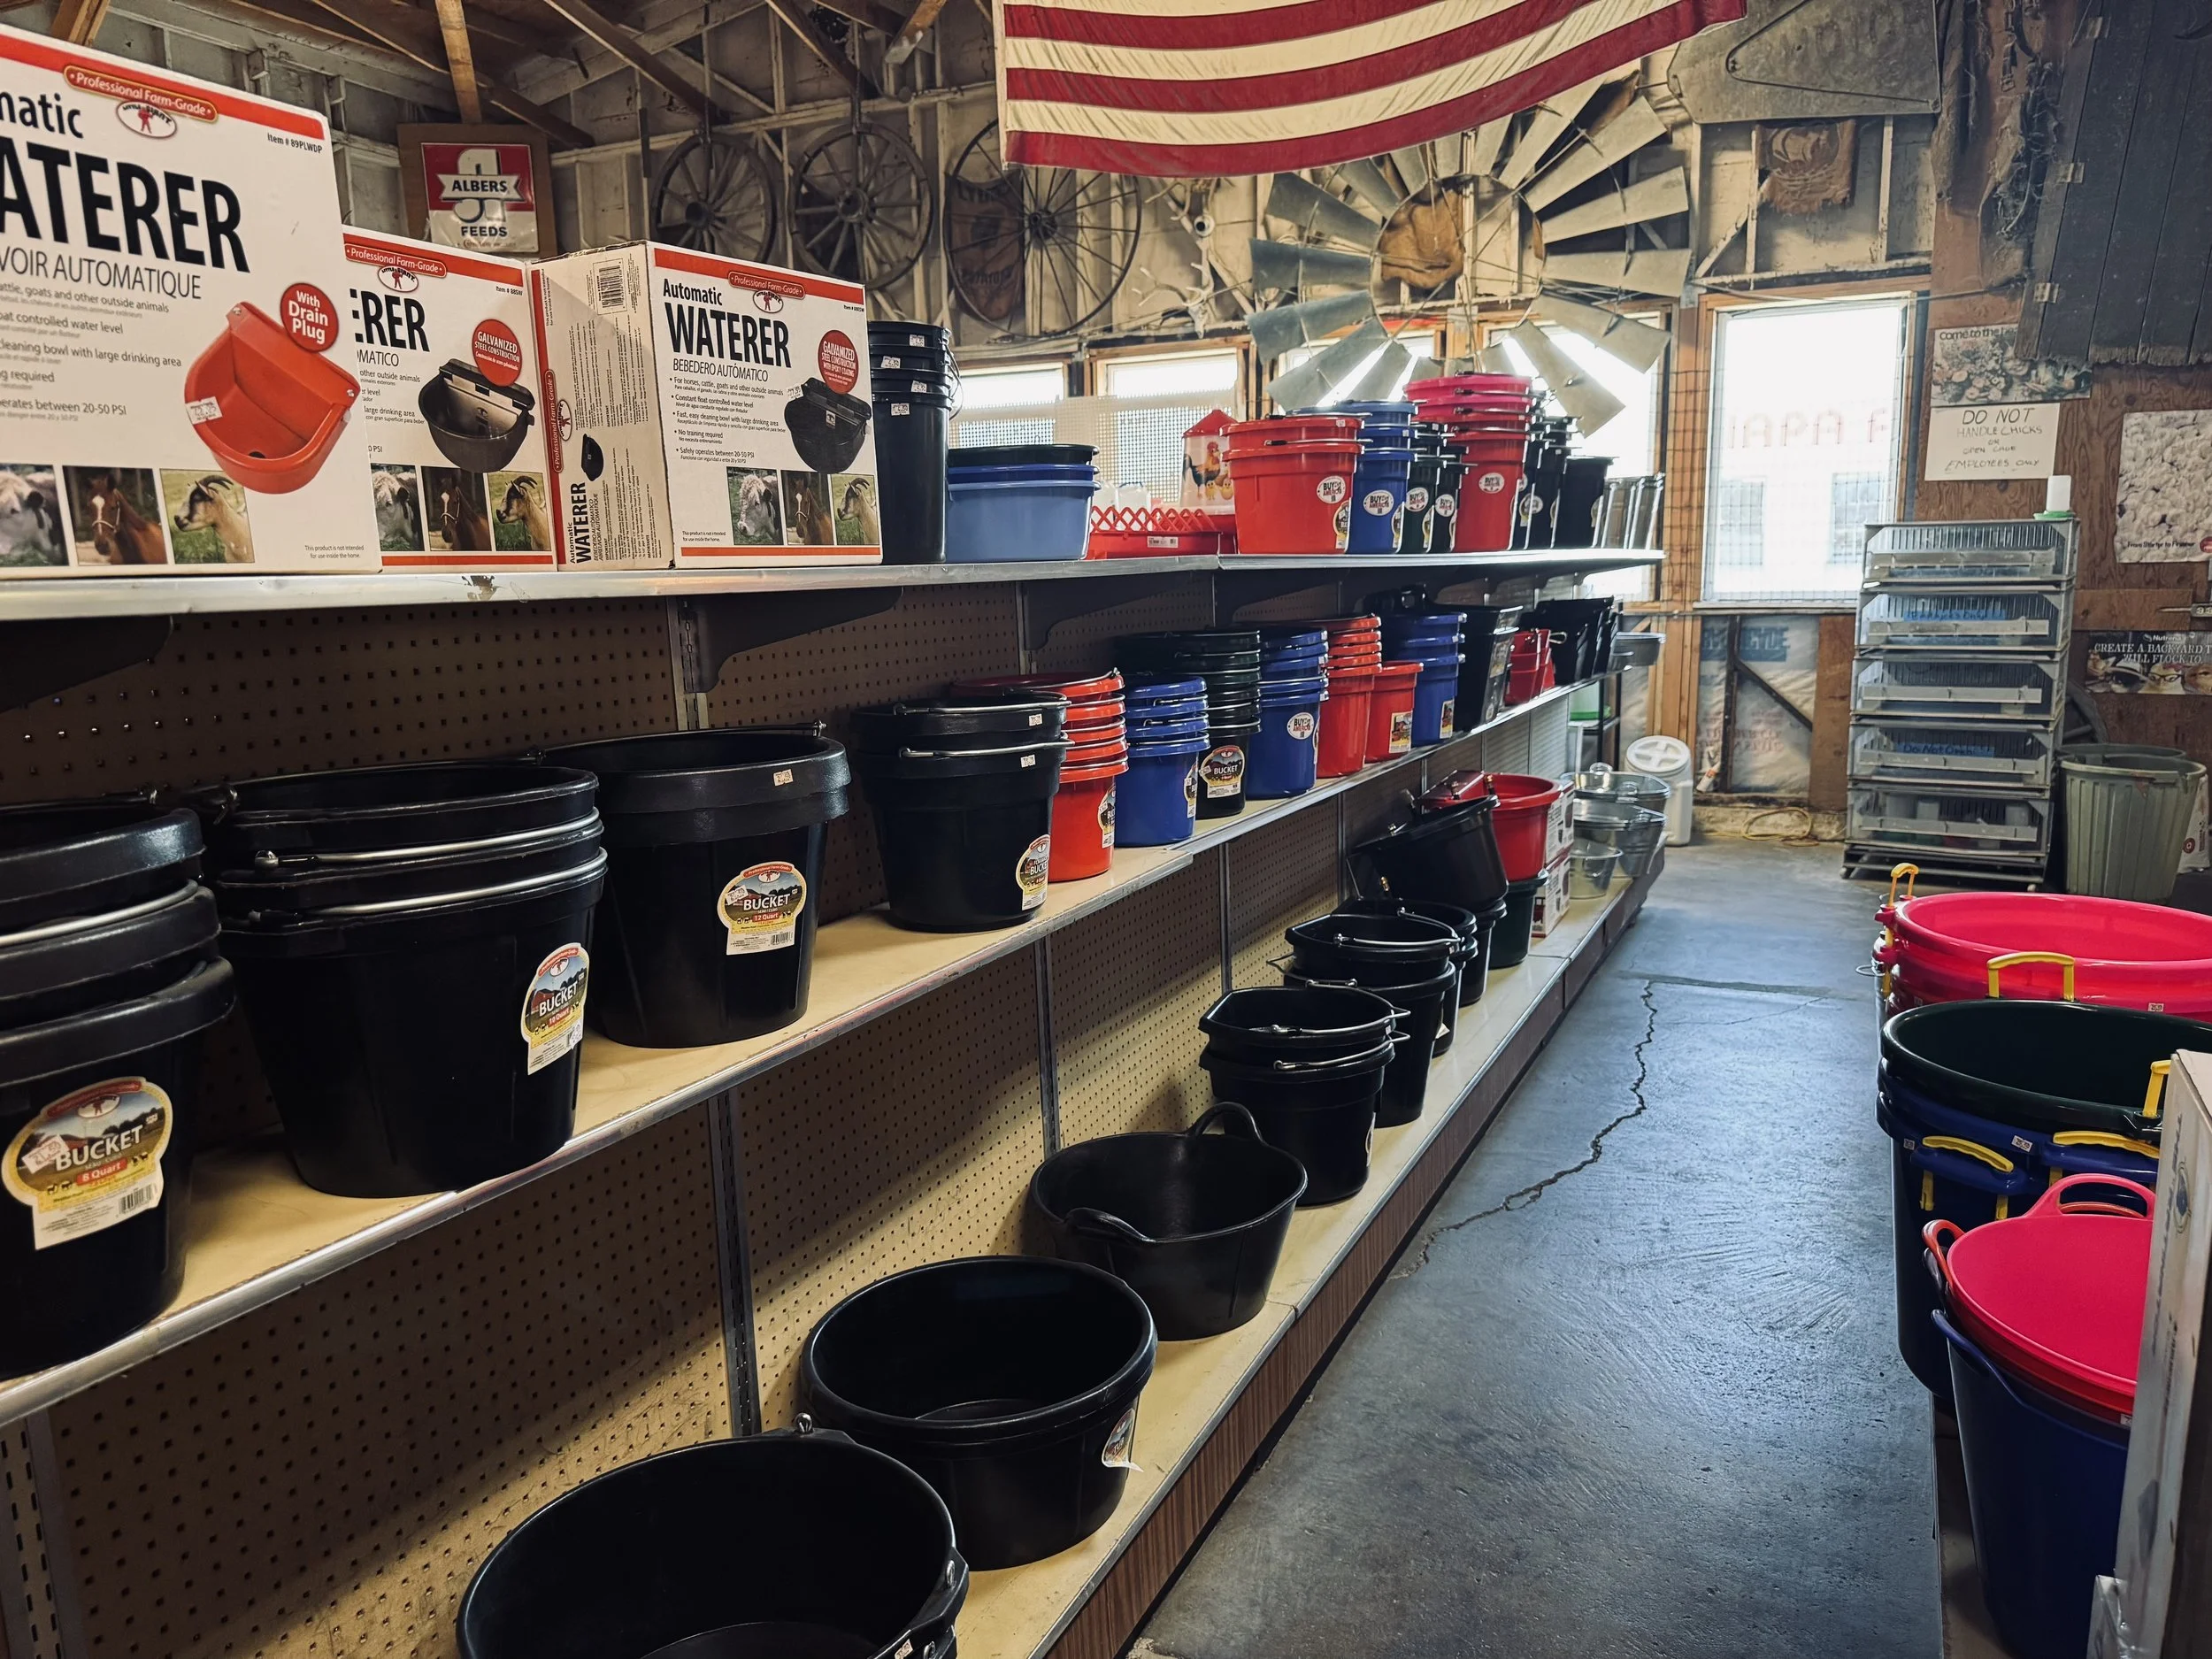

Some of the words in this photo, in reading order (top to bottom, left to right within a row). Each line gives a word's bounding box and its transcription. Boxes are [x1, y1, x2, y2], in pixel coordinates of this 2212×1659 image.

[76, 72, 143, 99] Professional
[144, 88, 206, 116] Farm-Grade
[267, 133, 283, 144] Item
[451, 180, 508, 192] ALBERS
[461, 226, 508, 237] FEEDS
[350, 248, 396, 266] Professional
[396, 257, 439, 273] Farm-Grade
[53, 254, 202, 299] AUTOMATIQUE
[733, 275, 767, 288] Professional
[767, 282, 800, 295] Farm-Grade
[25, 287, 51, 299] goats
[54, 289, 72, 301] and
[73, 292, 98, 304] other
[101, 295, 134, 309] outside
[136, 300, 170, 312] animals
[296, 290, 320, 309] With
[663, 278, 723, 306] Automatic
[288, 300, 328, 326] Drain
[16, 312, 69, 328] controlled
[71, 319, 99, 332] water
[101, 321, 123, 334] level
[292, 318, 326, 345] Plug
[478, 331, 518, 354] GALVANIZED
[664, 302, 792, 368] WATERER
[1939, 330, 1968, 341] Come
[1970, 329, 1981, 339] to
[1982, 327, 2001, 336] the
[43, 343, 69, 356] bowl
[71, 347, 93, 358] with
[95, 349, 119, 363] large
[121, 351, 160, 367] drinking
[162, 357, 182, 367] area
[474, 341, 488, 352] STEEL
[488, 346, 520, 363] CONSTRUCTION
[822, 352, 831, 362] STEEL
[823, 340, 855, 361] GALVANIZED
[359, 369, 375, 378] other
[378, 372, 398, 380] outside
[399, 374, 420, 383] animals
[673, 358, 717, 376] BEBEDERO
[11, 370, 55, 383] required
[684, 378, 700, 387] horses,
[35, 400, 80, 412] between
[82, 403, 110, 415] 20-50
[112, 404, 127, 415] PSI
[547, 379, 557, 421] Farm-Grade
[675, 394, 697, 403] Constant
[364, 405, 378, 415] large
[380, 407, 402, 417] drinking
[701, 413, 718, 422] cleaning
[1962, 410, 1987, 425] DO
[1996, 408, 2035, 424] NOT
[1957, 427, 1998, 438] HANDLE
[2001, 426, 2042, 436] CHICKS
[551, 422, 560, 465] Professional
[1947, 459, 2009, 471] EMPLOYEES
[2016, 458, 2039, 467] ONLY
[1323, 482, 1334, 491] BUY
[570, 482, 592, 563] WATERER
[2094, 643, 2134, 653] CREATE
[2139, 644, 2146, 653] A
[2147, 643, 2203, 654] BACKYARD
[2124, 654, 2150, 663] WILL
[2153, 654, 2185, 664] FLOCK
[1294, 718, 1305, 726] BUY
[1903, 744, 1919, 753] Do
[1922, 744, 1946, 754] Not
[1214, 764, 1238, 775] BUCKET
[743, 893, 791, 911] BUCKET
[539, 980, 579, 1018] BUCKET
[556, 1008, 569, 1022] Quart
[55, 1125, 143, 1171] BUCKET
[81, 1172, 89, 1181] 8
[91, 1163, 122, 1180] Quart
